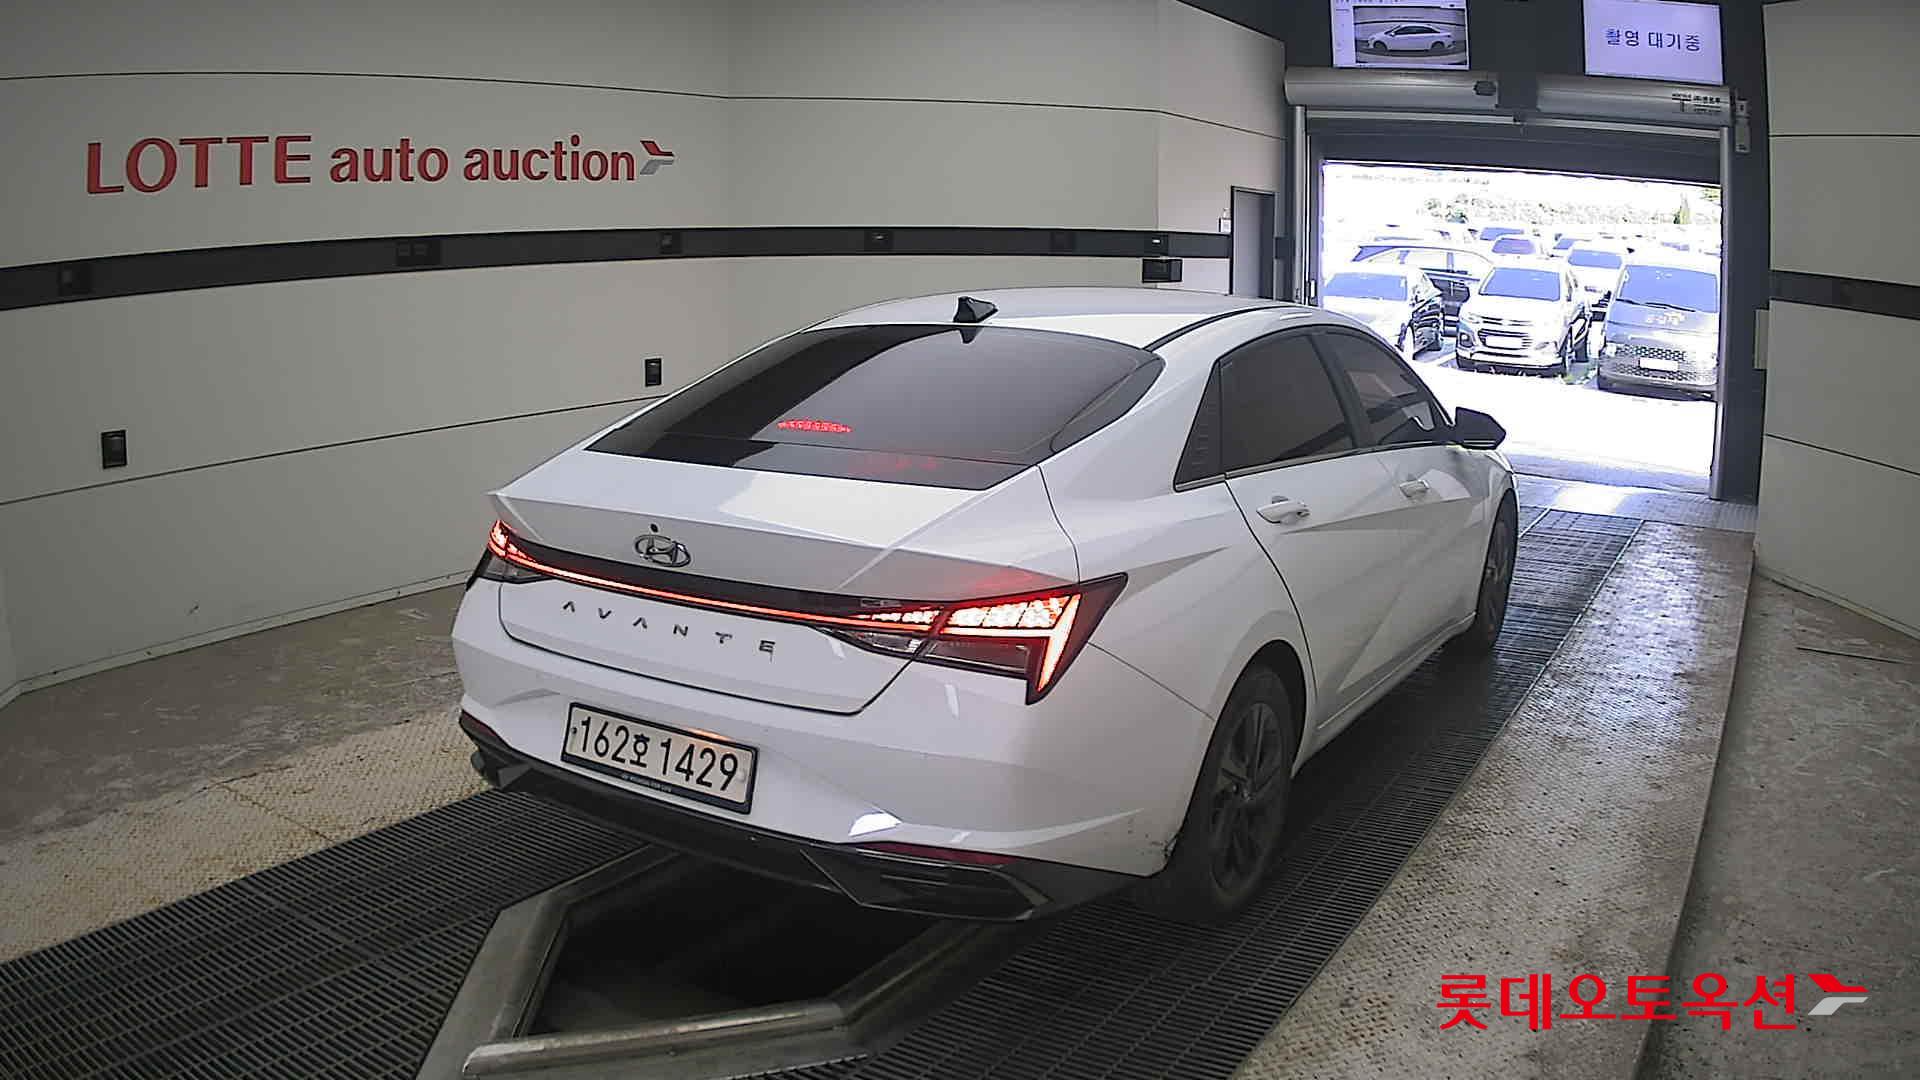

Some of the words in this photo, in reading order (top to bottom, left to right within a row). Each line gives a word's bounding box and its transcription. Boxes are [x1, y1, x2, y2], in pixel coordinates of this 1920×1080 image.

[1605, 28, 1640, 47] 촬영
[1647, 31, 1701, 52] 대기중
[86, 134, 312, 194] LOTTE
[329, 138, 449, 183] auto
[463, 134, 636, 183] auction
[562, 600, 776, 654] AVANTE
[580, 715, 651, 769] 162호
[659, 737, 739, 792] 1429
